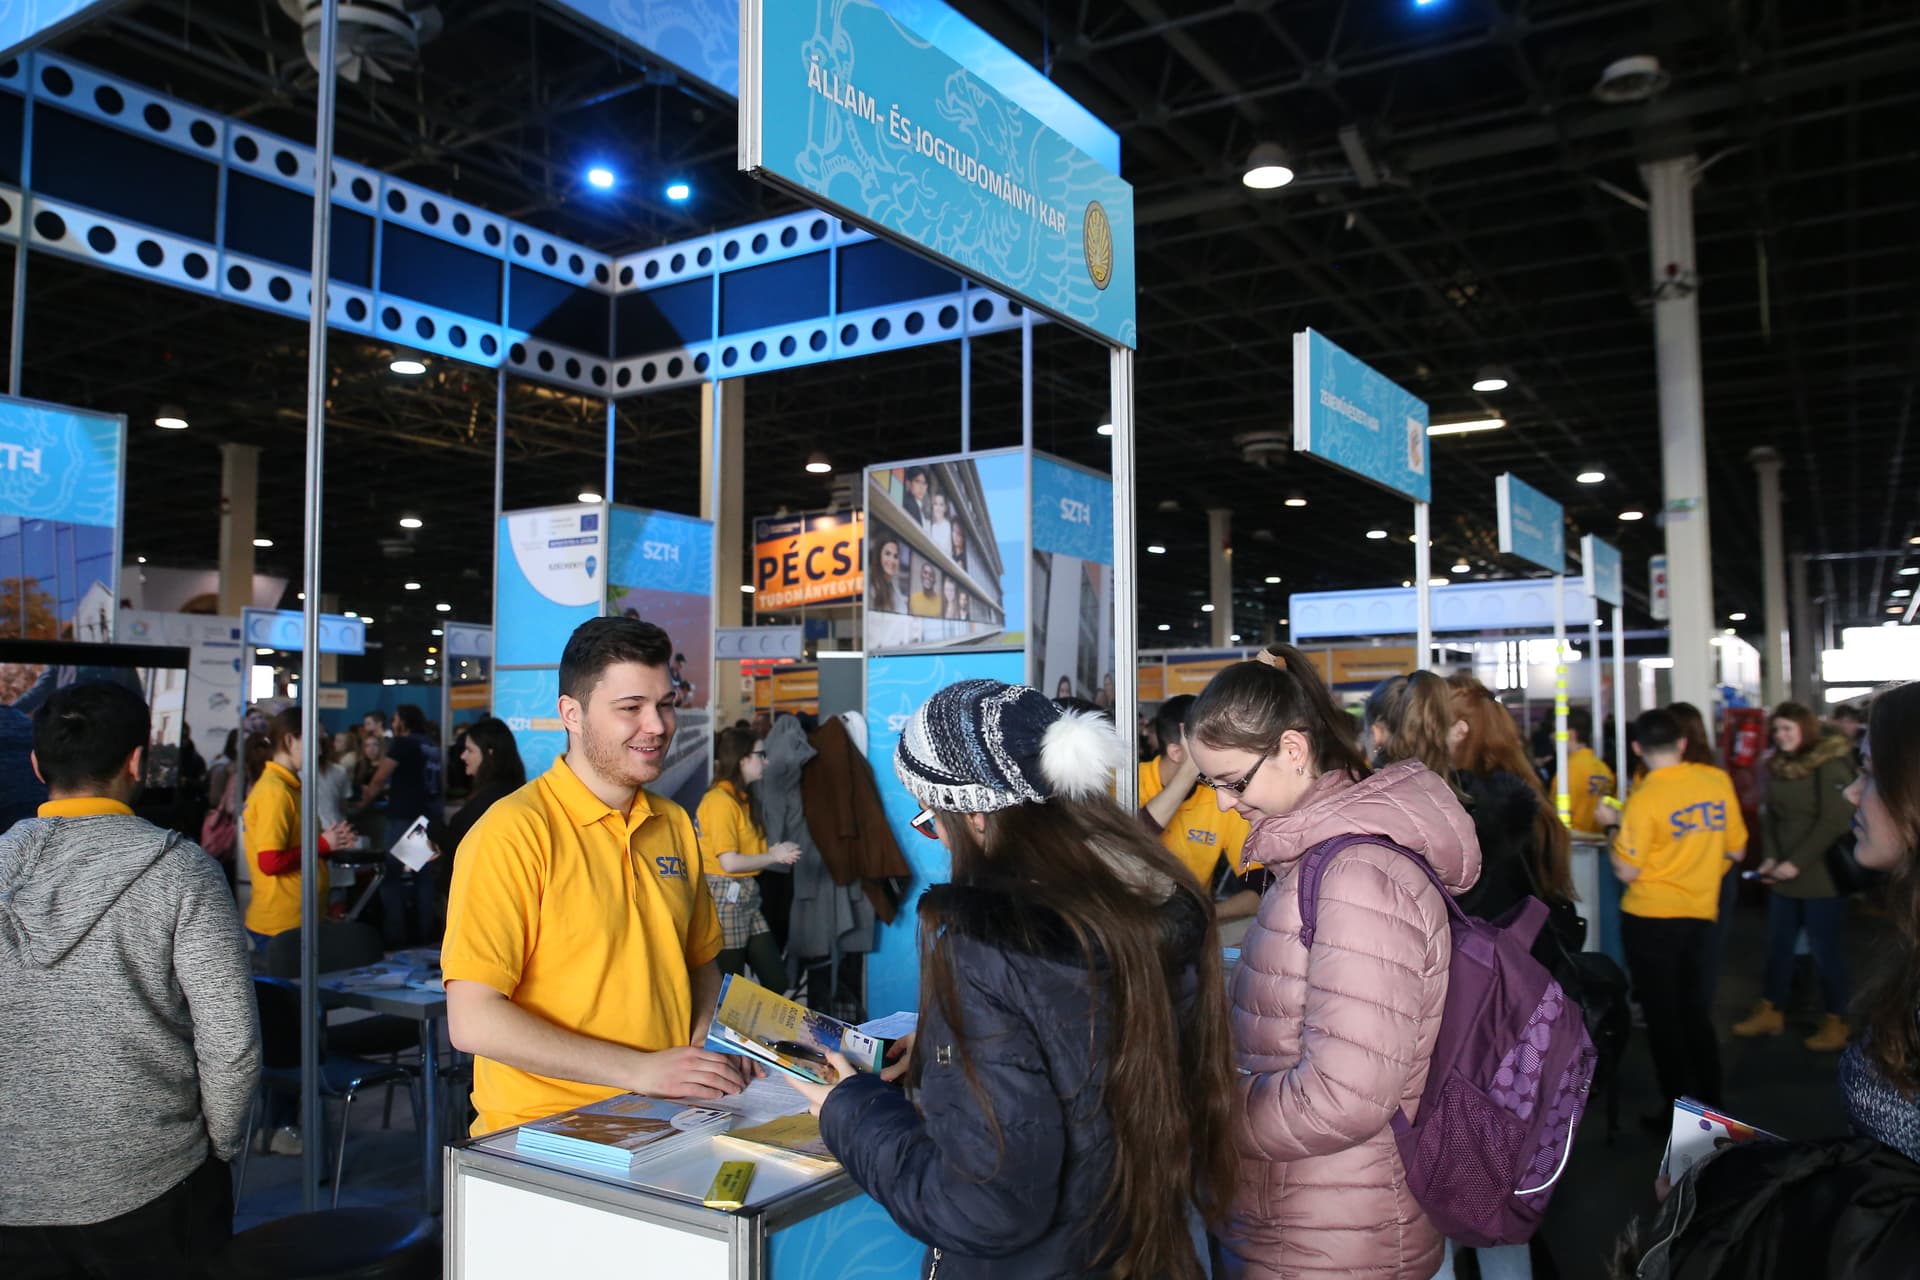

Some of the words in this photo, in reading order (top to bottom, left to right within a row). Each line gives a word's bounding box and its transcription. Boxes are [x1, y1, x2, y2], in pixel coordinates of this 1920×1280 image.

[807, 55, 884, 125] ÁLLAM-
[889, 103, 912, 145] ÉS
[915, 125, 1037, 219] JOGTUDOMÁNYI
[1038, 200, 1067, 236] KAR
[0, 442, 41, 475] TE
[642, 540, 680, 563] SZTE
[1668, 799, 1726, 838] SZTE
[1187, 828, 1217, 847] SZTE
